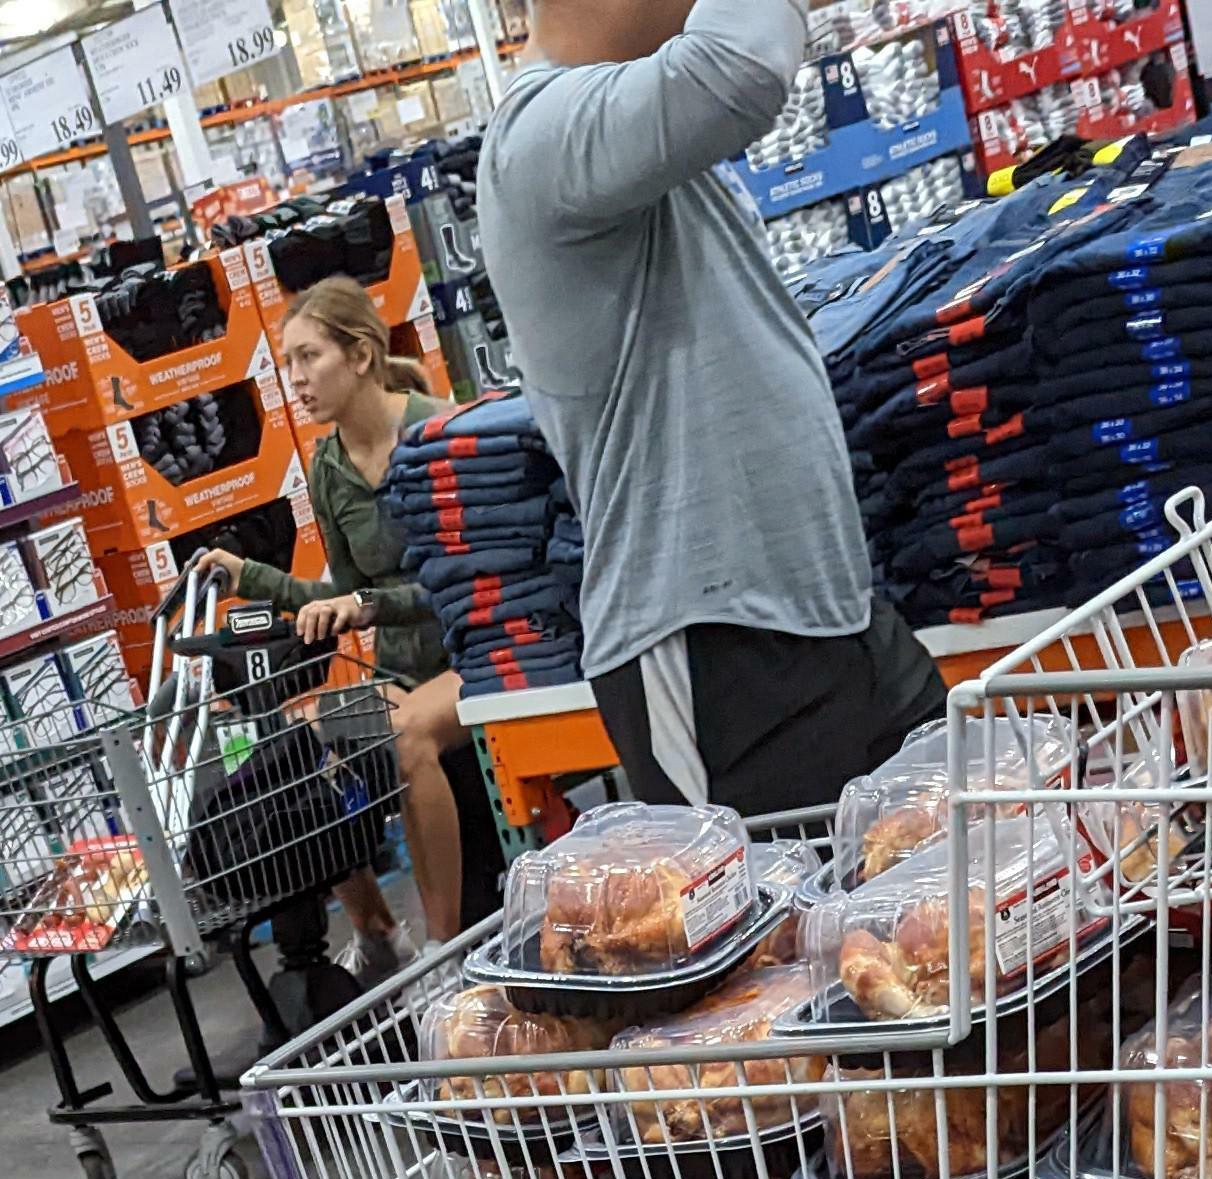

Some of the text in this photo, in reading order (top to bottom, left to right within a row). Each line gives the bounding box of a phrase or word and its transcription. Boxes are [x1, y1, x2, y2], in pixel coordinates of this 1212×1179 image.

[961, 14, 969, 30] 8
[227, 26, 275, 67] 18.99
[136, 67, 182, 105] 11.49
[840, 61, 855, 89] 8
[50, 106, 94, 143] 18.49
[867, 190, 881, 217] 8
[253, 246, 266, 267] 5
[78, 299, 92, 324] 5
[148, 352, 223, 386] WEATHERPROOF
[115, 426, 128, 449] 5
[184, 472, 256, 507] WEATHERPROOF
[155, 548, 168, 570] 5
[250, 650, 266, 681] 8
